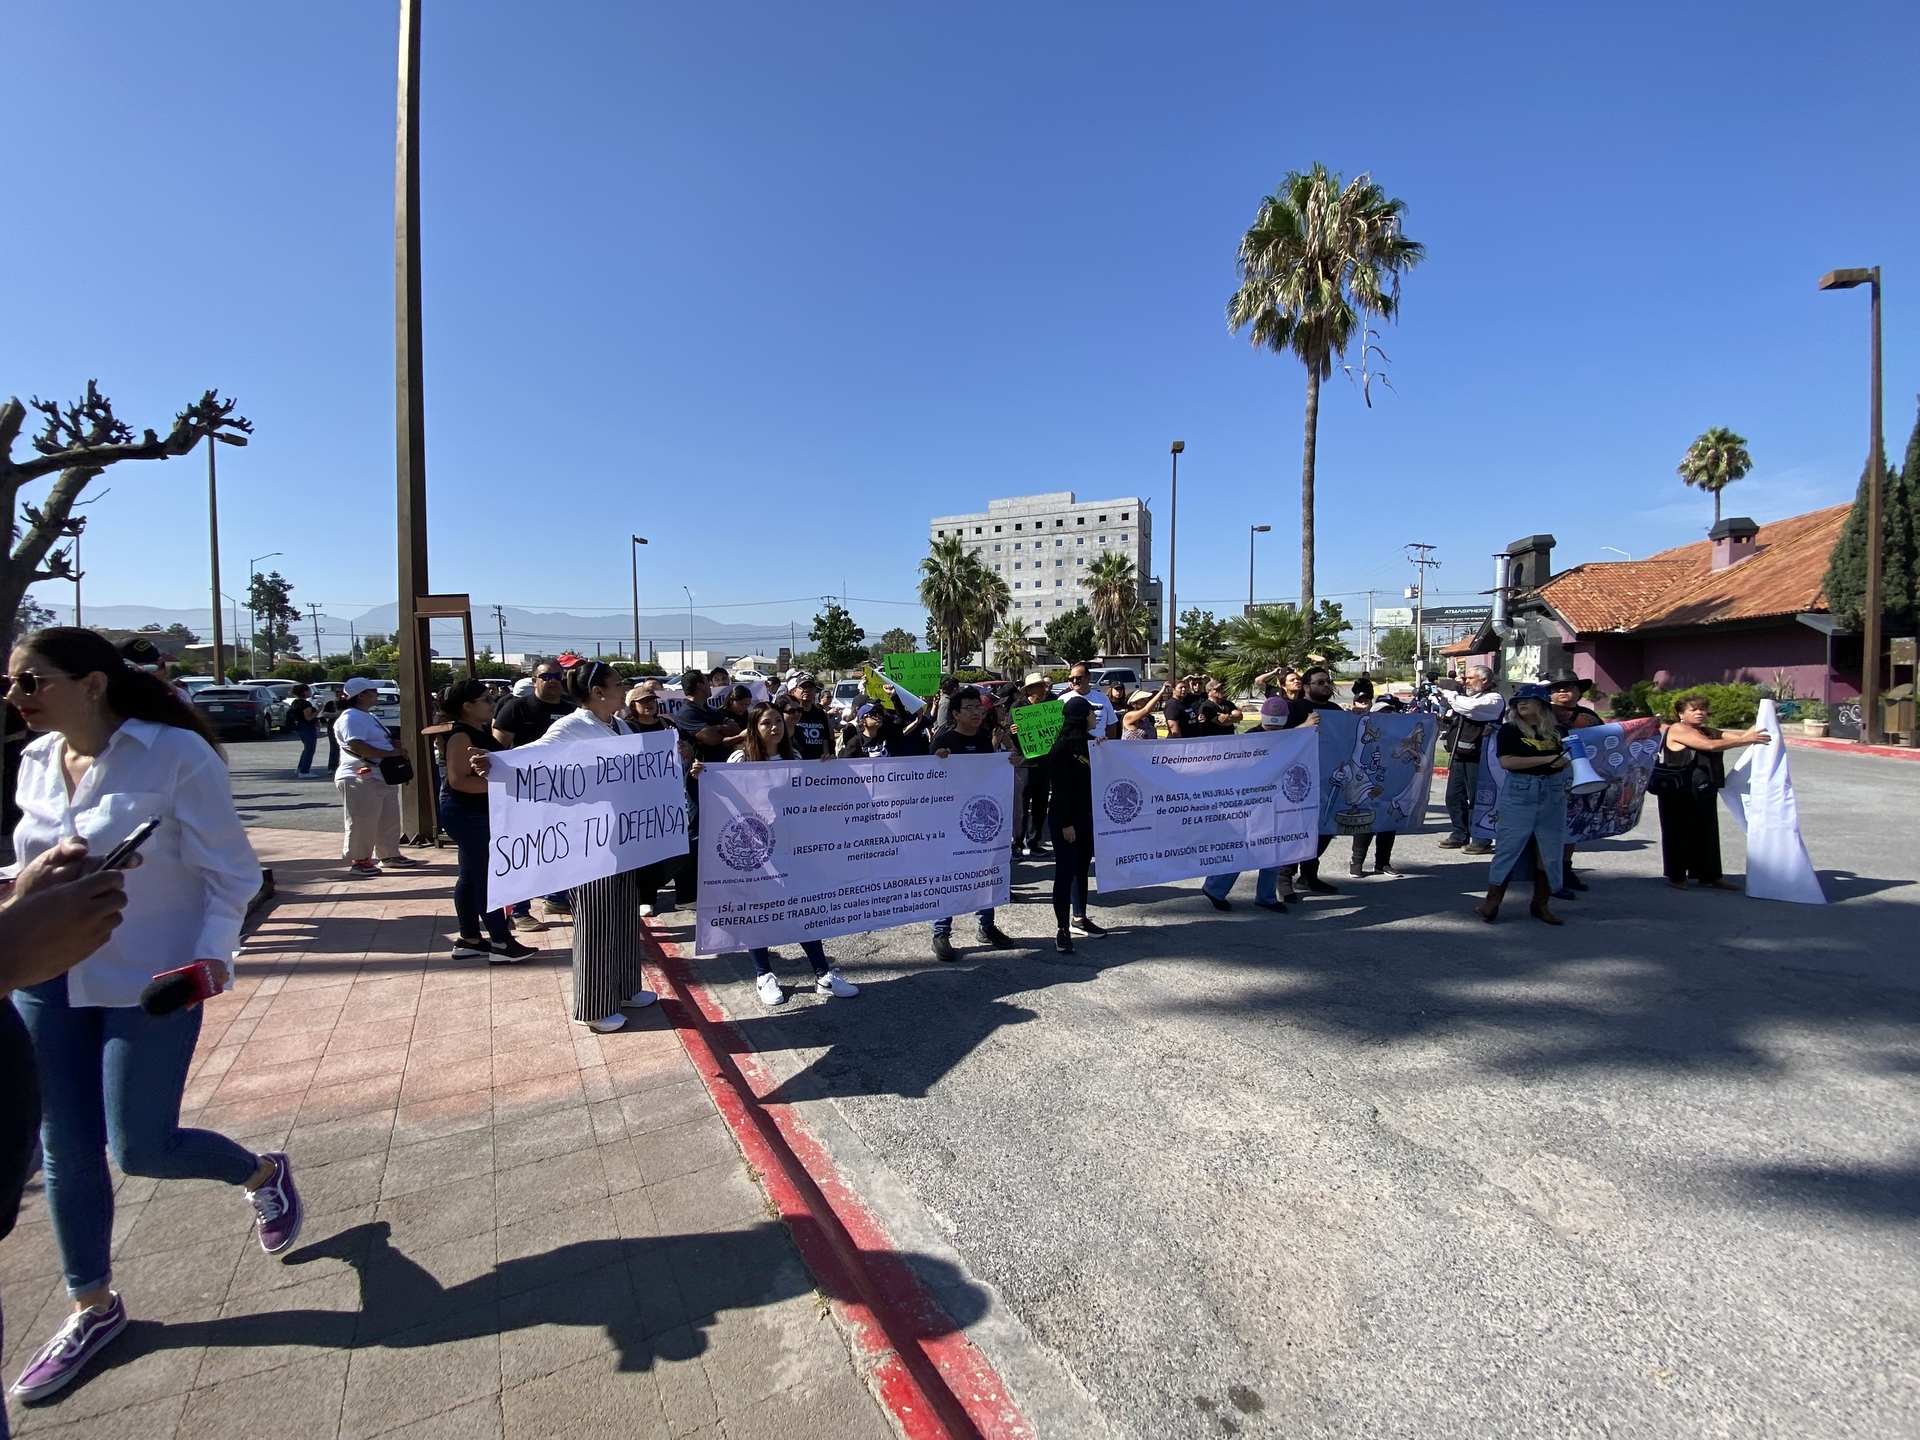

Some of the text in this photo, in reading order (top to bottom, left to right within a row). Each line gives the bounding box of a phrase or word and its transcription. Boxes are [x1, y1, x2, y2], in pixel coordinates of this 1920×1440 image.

[888, 654, 940, 670] La Justicia
[890, 673, 903, 682] NO
[1021, 732, 1034, 743] TE
[1152, 756, 1159, 764] El
[1161, 754, 1221, 764] Decimonoveno
[1224, 750, 1252, 760] Circuito
[516, 750, 678, 803] MÉXICO DESPIERTA,
[792, 769, 948, 788] El Decimonoveno Circuito dice:
[1151, 794, 1164, 804] ¡YA
[1166, 793, 1192, 802] BASTA,
[1192, 792, 1201, 800] de
[1202, 788, 1234, 798] INJURIAS
[1242, 784, 1277, 796] generación
[783, 806, 800, 816] ¡NO
[820, 802, 854, 812] elección
[856, 801, 870, 811] por
[872, 800, 889, 808] voto
[891, 797, 918, 808] popular
[920, 796, 929, 804] de
[930, 795, 954, 804] jueces
[1156, 807, 1166, 815] de
[1168, 806, 1188, 814] ODIO
[1190, 804, 1210, 812] hacia
[1220, 800, 1242, 808] PODER
[844, 810, 902, 824] y magistrados!
[1182, 817, 1192, 825] DE
[495, 822, 570, 876] SOMOS
[584, 814, 609, 857] TU
[794, 842, 834, 856] ¡RESPETO
[853, 836, 890, 848] CARRERA
[891, 832, 924, 844] JUDICIAL
[1116, 853, 1148, 866] ¡RESPETO
[1164, 845, 1198, 858] DIVISIÓN
[1200, 844, 1209, 853] DE
[1210, 841, 1243, 852] PODERES
[1245, 841, 1250, 850] y
[1250, 838, 1256, 847] la
[1257, 832, 1309, 846] INDEPENDENCIA
[848, 848, 898, 862] meritocracia!
[1200, 854, 1234, 866] JUDICIAL!
[718, 902, 734, 914] ¡SÍ,
[737, 902, 746, 912] al
[749, 900, 785, 911] respeto
[788, 896, 798, 906] de
[801, 891, 836, 904] nuestros
[838, 882, 881, 896] DERECHOS
[883, 876, 927, 890] LABORALES
[942, 874, 952, 882] las
[954, 866, 1000, 880] CONDICIONES
[711, 914, 769, 926] GENERALES
[772, 912, 784, 922] DE
[787, 905, 828, 919] TRABAJO,
[830, 903, 841, 912] las
[844, 898, 870, 909] cuales
[872, 893, 902, 904] integran
[911, 890, 922, 898] las
[924, 883, 972, 896] CONQUISTAS
[974, 876, 1004, 890] LABRALES
[804, 900, 940, 930] obtenidas por la base trabajadora!
